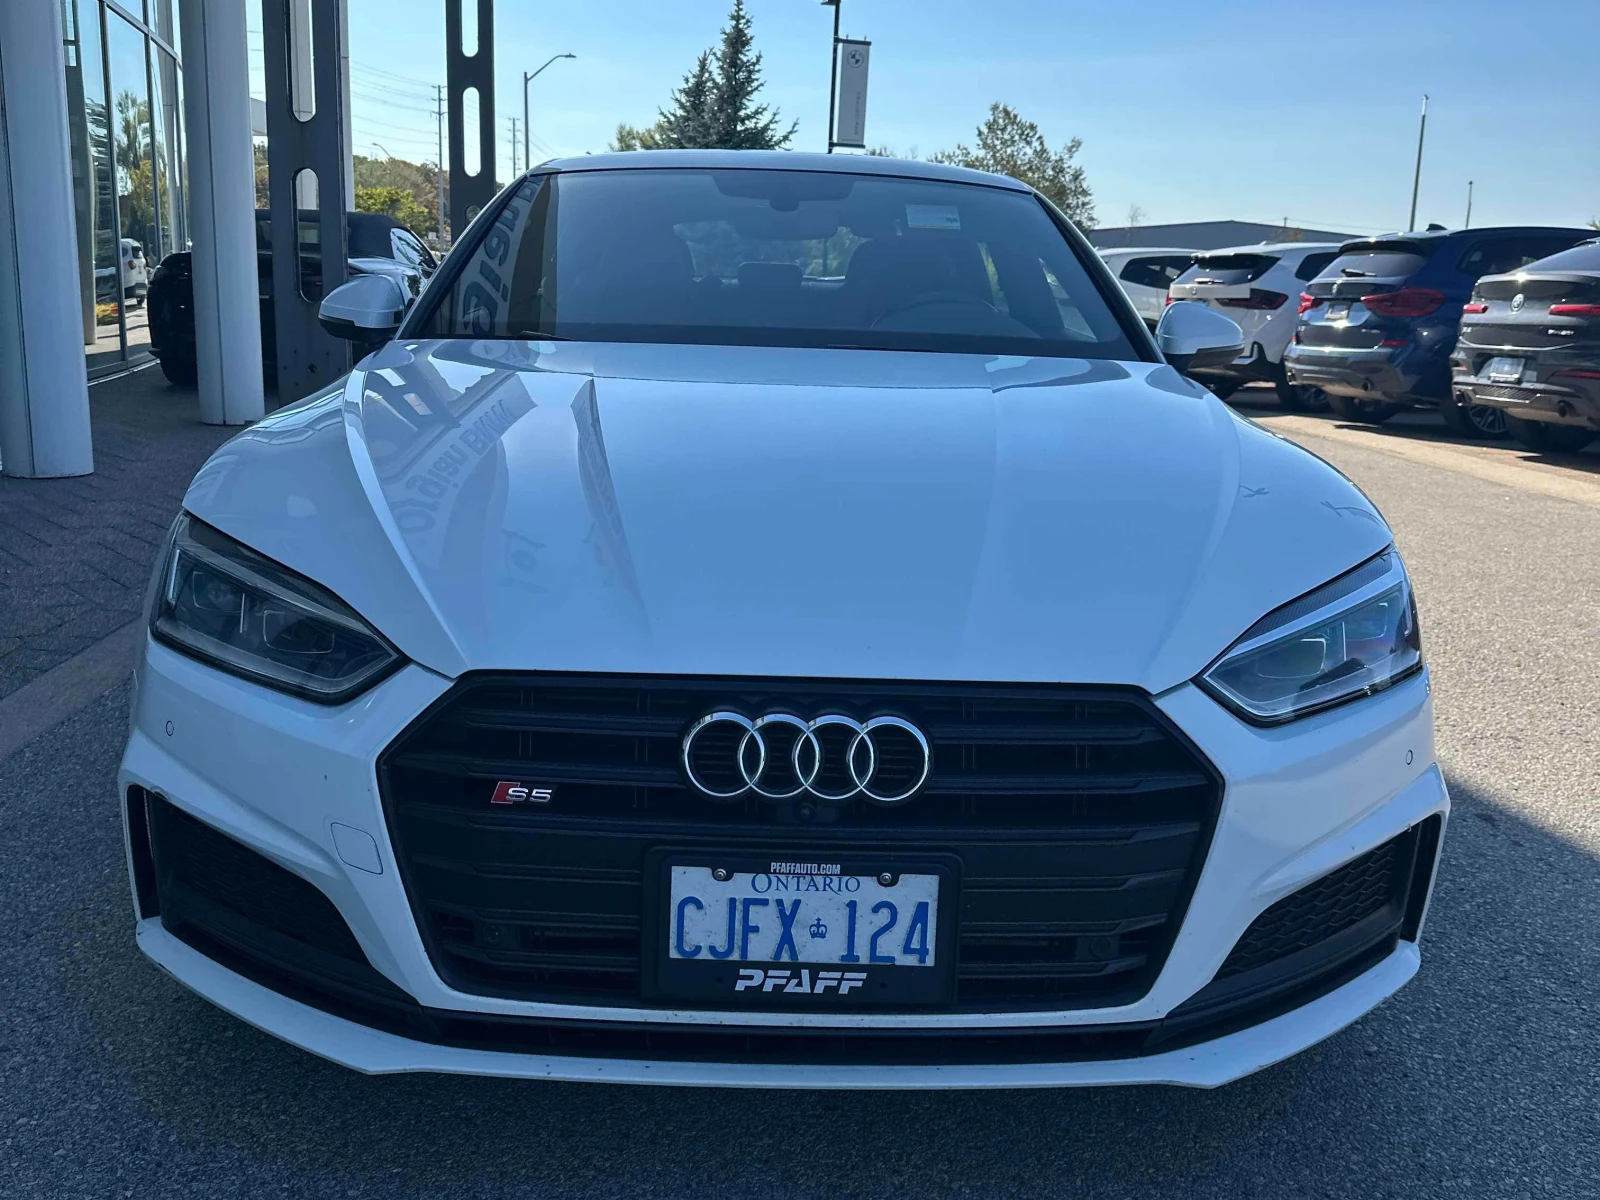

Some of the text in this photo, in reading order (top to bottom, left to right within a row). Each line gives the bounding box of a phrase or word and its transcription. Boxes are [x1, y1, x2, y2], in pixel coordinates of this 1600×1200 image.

[505, 787, 553, 803] S5
[770, 862, 841, 874] PFAFFAUTO.COM
[676, 896, 930, 964] CJFX 124
[734, 968, 868, 995] PFAFF
